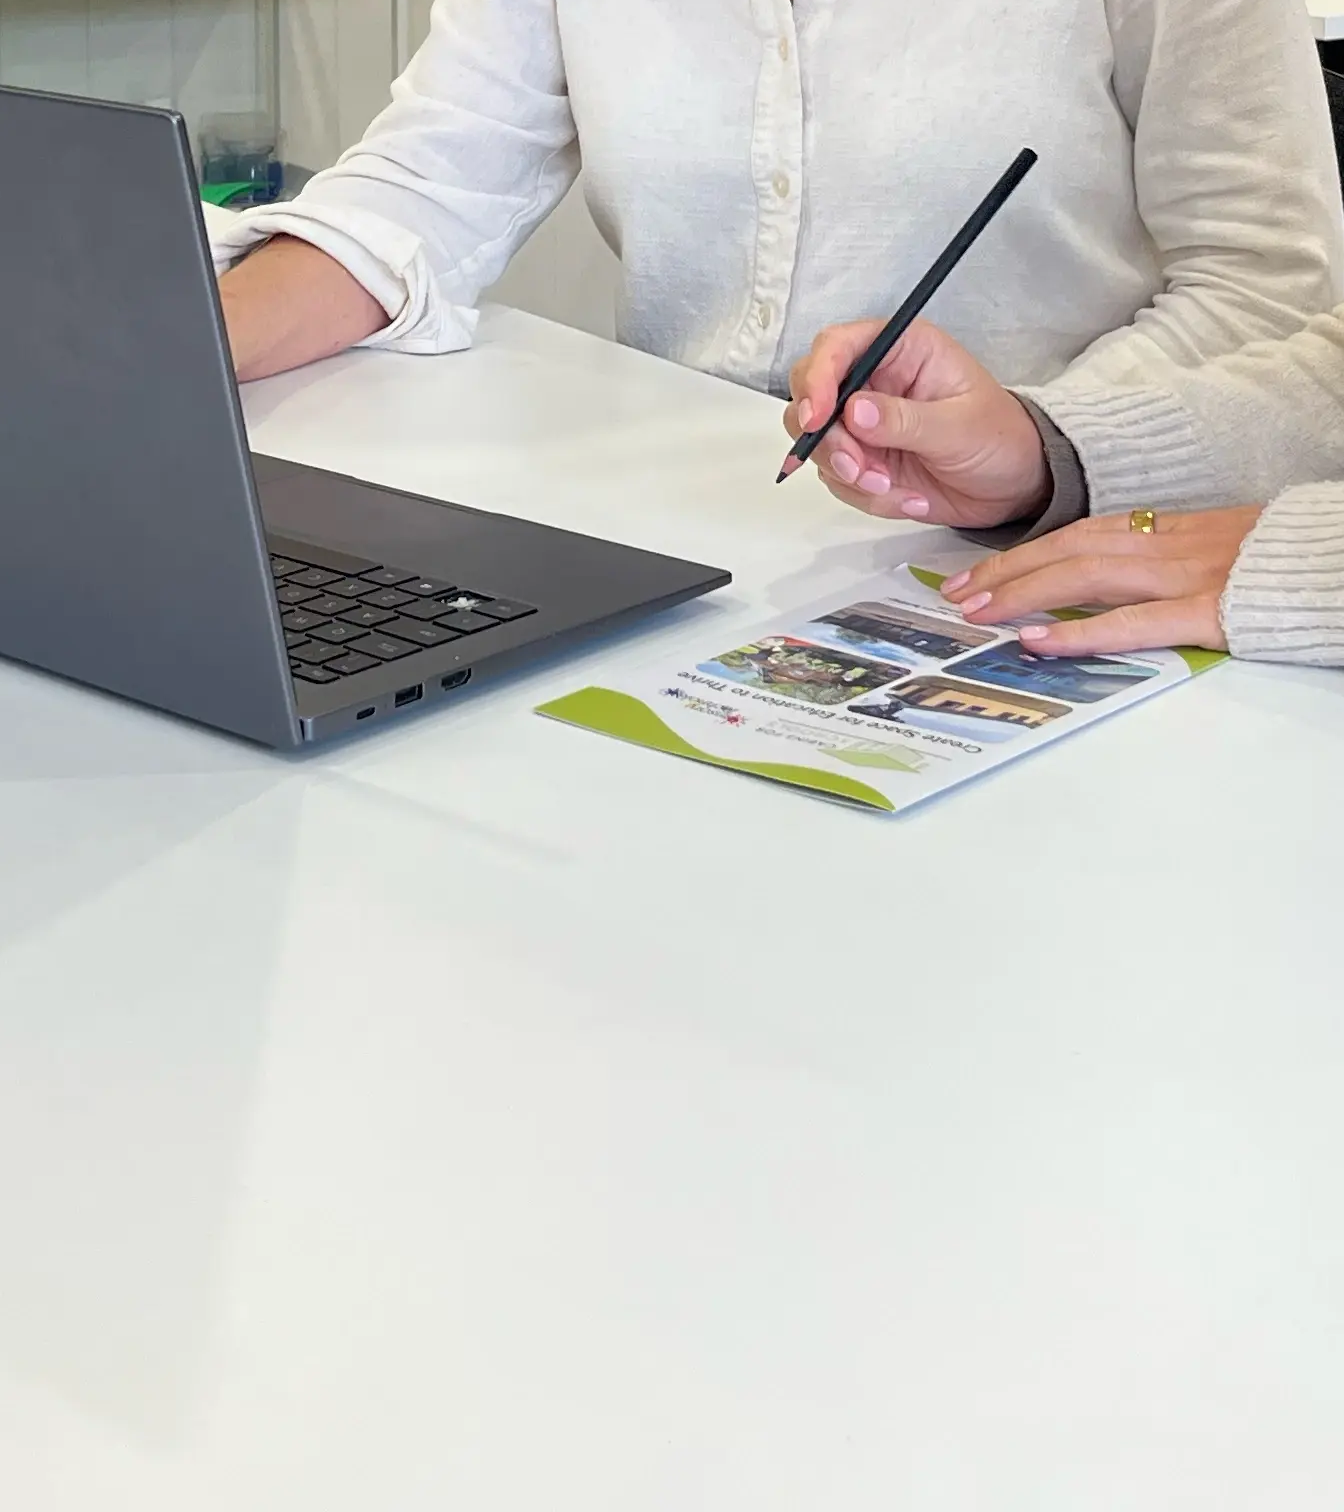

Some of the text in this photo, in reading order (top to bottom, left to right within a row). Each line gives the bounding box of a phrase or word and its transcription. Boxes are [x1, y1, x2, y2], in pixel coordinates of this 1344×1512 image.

[676, 670, 729, 693] Thrive
[729, 686, 752, 699] to
[752, 693, 836, 720] Education
[834, 712, 865, 728] for
[866, 719, 920, 739] Space
[921, 733, 983, 755] Create
